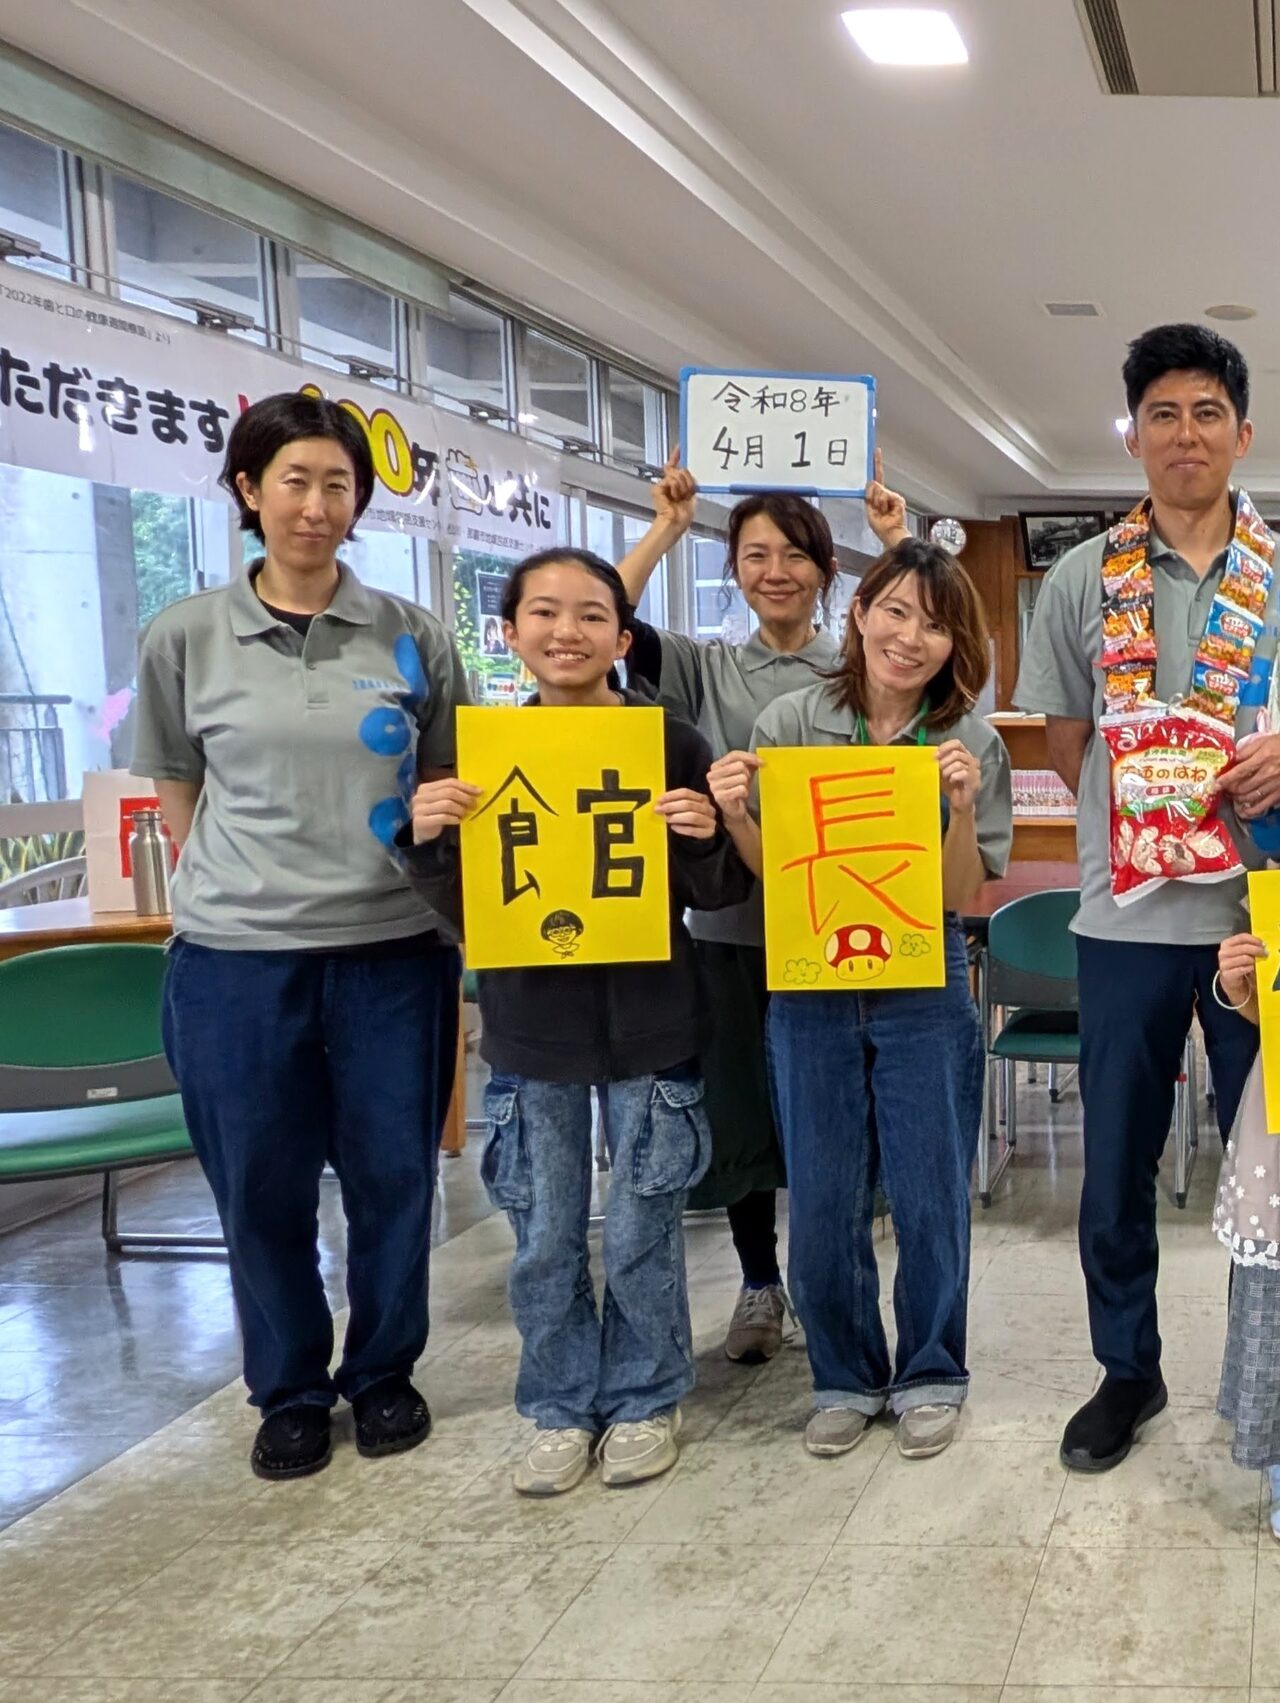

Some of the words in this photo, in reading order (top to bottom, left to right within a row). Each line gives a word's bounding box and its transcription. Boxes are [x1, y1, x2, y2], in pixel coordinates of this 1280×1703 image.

[712, 381, 840, 417] 令和8年
[469, 765, 652, 906] 館
[781, 766, 937, 936] 長
